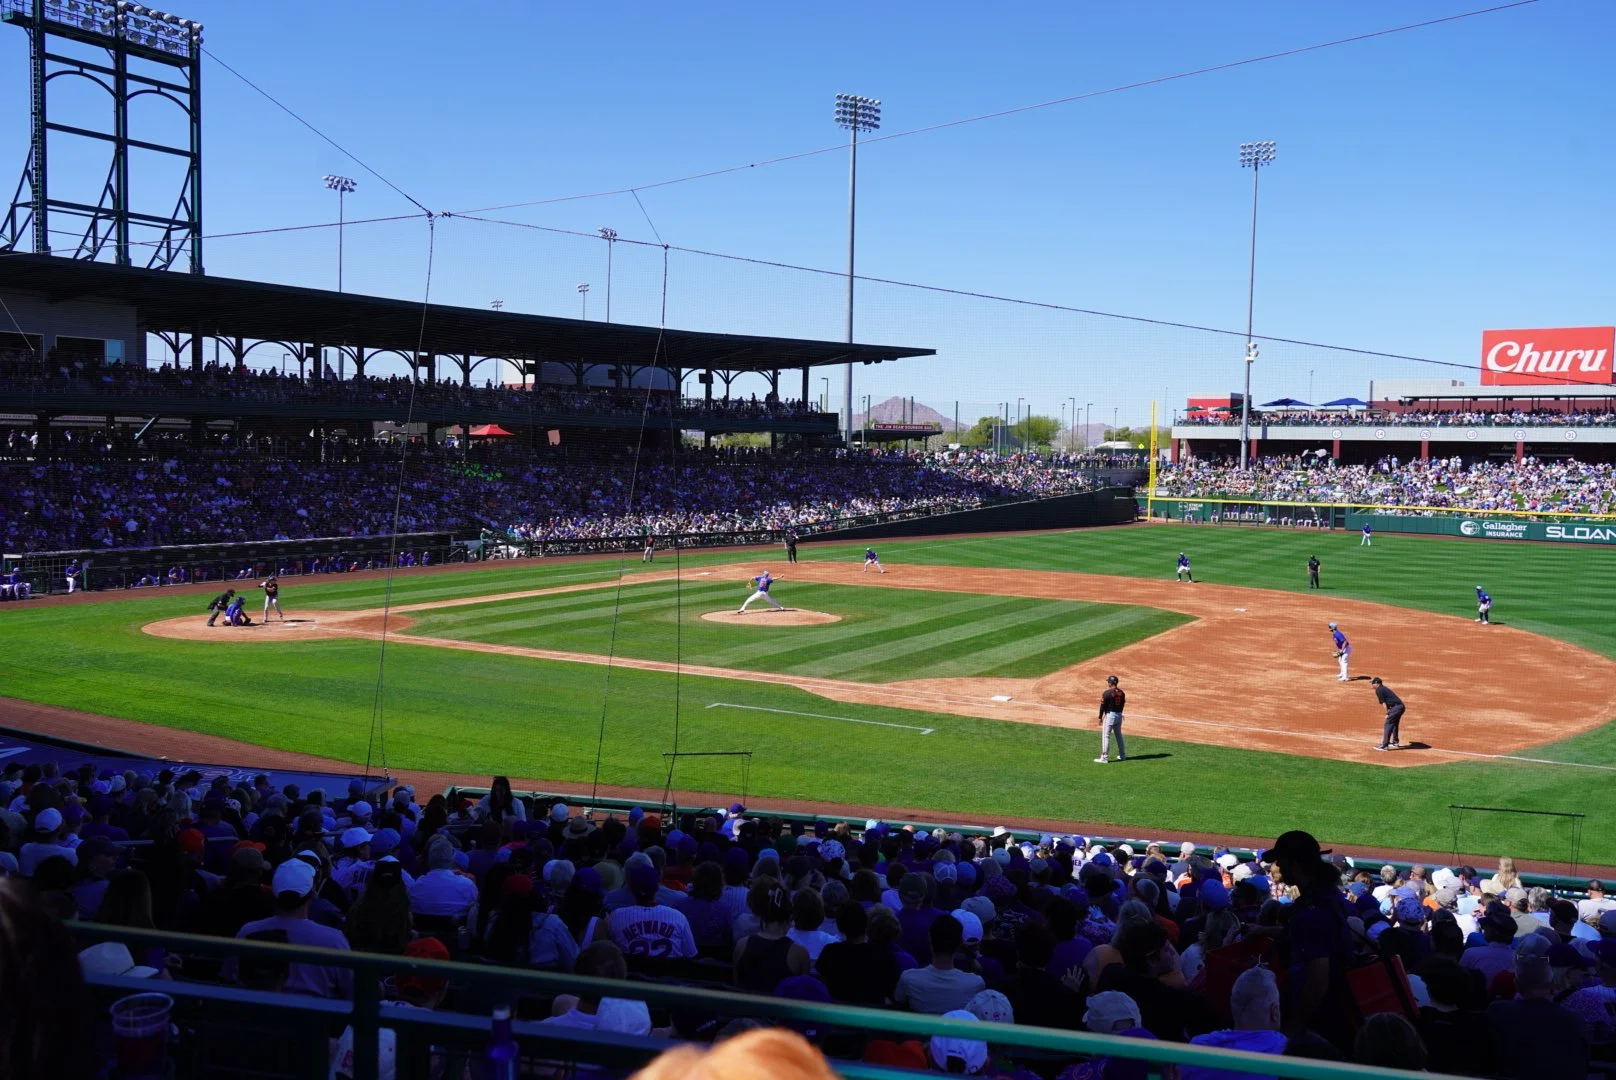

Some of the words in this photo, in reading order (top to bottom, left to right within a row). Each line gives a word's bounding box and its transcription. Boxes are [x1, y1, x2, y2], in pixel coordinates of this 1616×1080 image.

[1487, 341, 1608, 374] Churu
[1482, 521, 1528, 532] Gallagher
[1485, 530, 1523, 538] INSURANCE
[622, 920, 675, 942] HEYWARD
